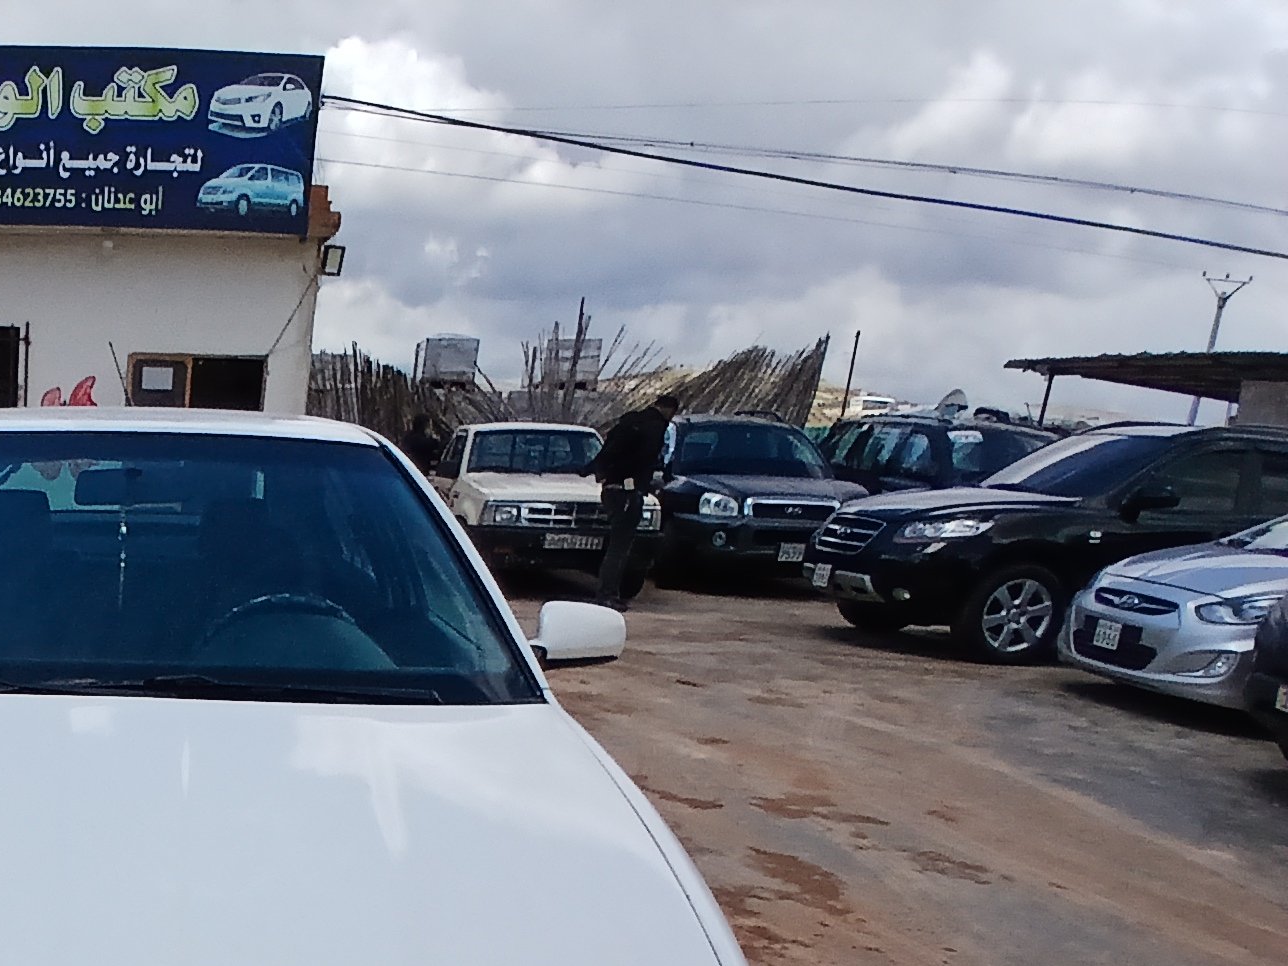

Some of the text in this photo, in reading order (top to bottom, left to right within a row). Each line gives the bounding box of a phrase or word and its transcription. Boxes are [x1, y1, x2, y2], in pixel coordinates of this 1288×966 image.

[70, 65, 199, 134] مكتب
[58, 150, 120, 179] جميع
[125, 145, 204, 178] لتجارة
[90, 185, 136, 212] عدنان
